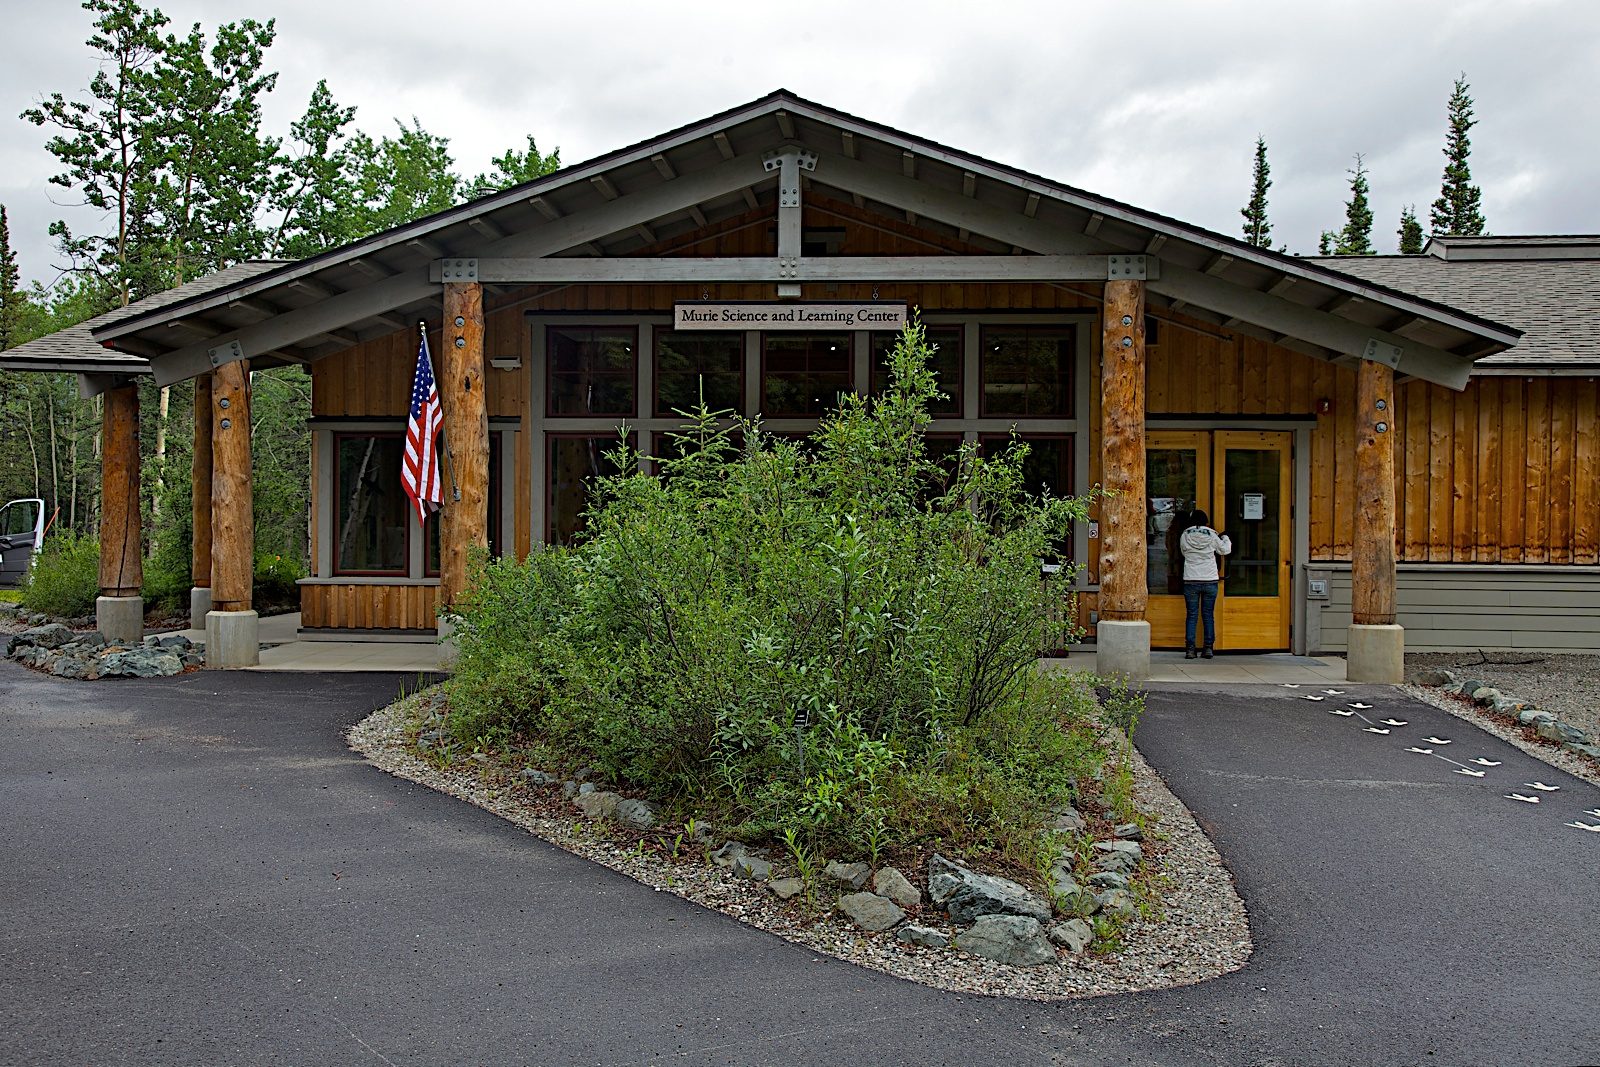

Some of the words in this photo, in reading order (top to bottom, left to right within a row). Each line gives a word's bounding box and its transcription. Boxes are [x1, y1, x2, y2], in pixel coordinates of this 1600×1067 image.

[681, 309, 719, 322] Murie
[721, 309, 768, 322] Science
[771, 309, 795, 322] and
[798, 309, 854, 325] Learning
[857, 309, 900, 322] Center
